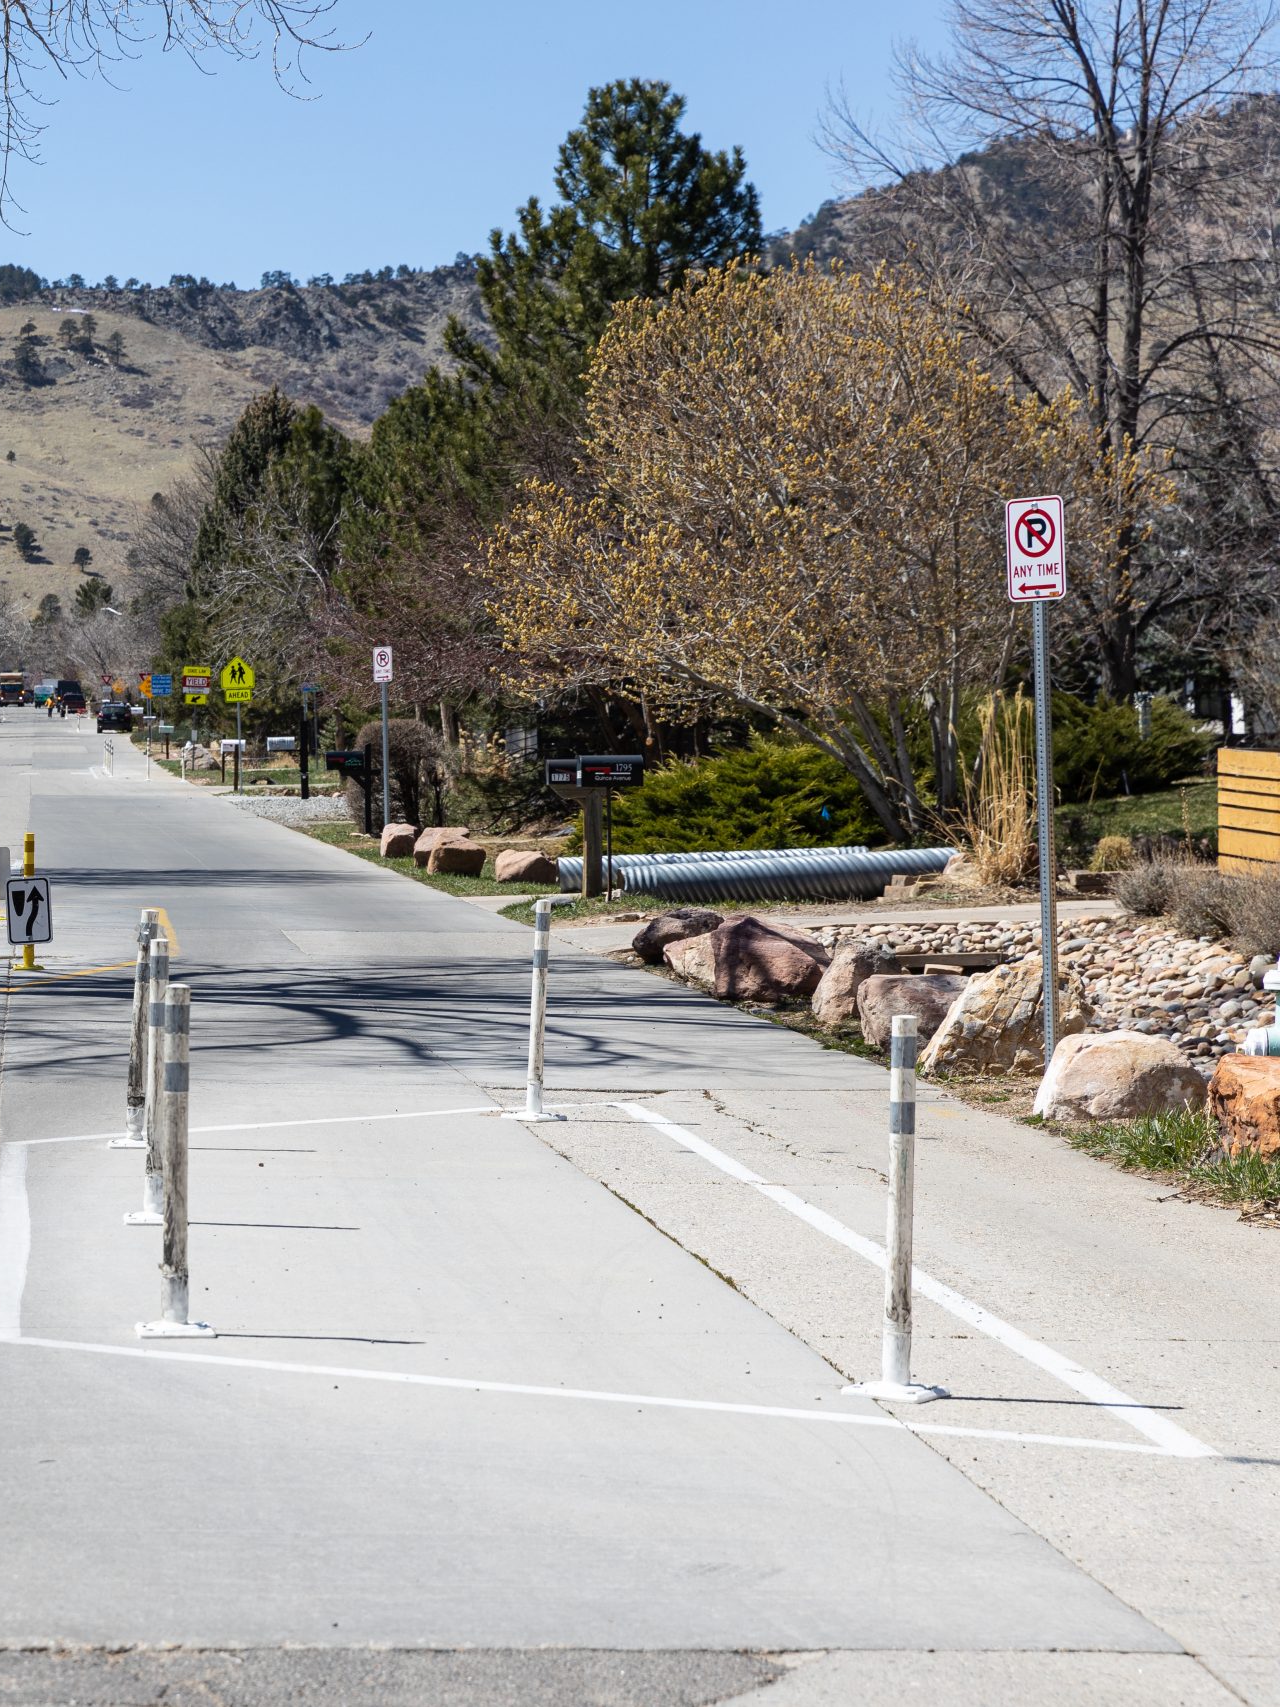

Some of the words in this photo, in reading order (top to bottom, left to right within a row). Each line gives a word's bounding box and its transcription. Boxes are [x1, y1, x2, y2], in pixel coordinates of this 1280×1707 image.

[1013, 565, 1033, 578] ANY
[1037, 562, 1060, 577] TIME
[187, 678, 207, 686] YIELD
[616, 764, 632, 772] 1795
